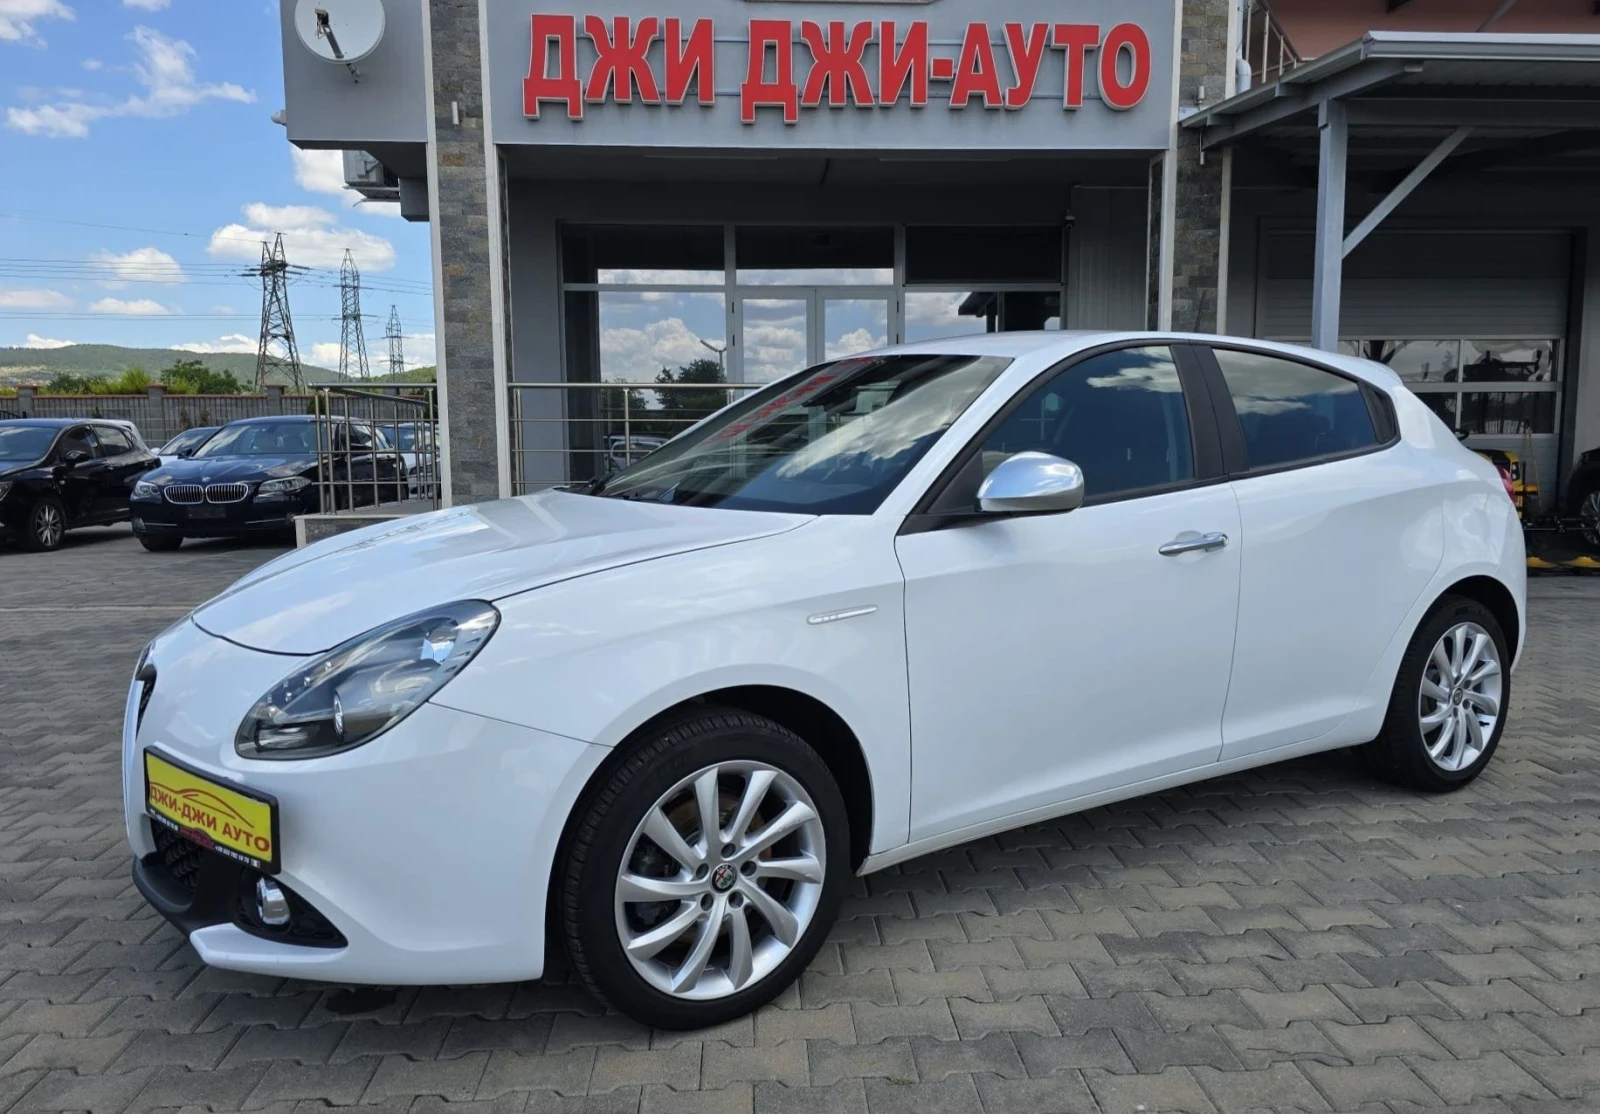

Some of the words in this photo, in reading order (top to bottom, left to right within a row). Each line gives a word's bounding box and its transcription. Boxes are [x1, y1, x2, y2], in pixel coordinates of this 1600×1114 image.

[523, 14, 715, 119] ДЖИ
[740, 19, 1152, 125] ДЖИ-АУТО
[150, 786, 217, 831] ДЖИ-ДЖИ
[222, 822, 270, 852] АУТО
